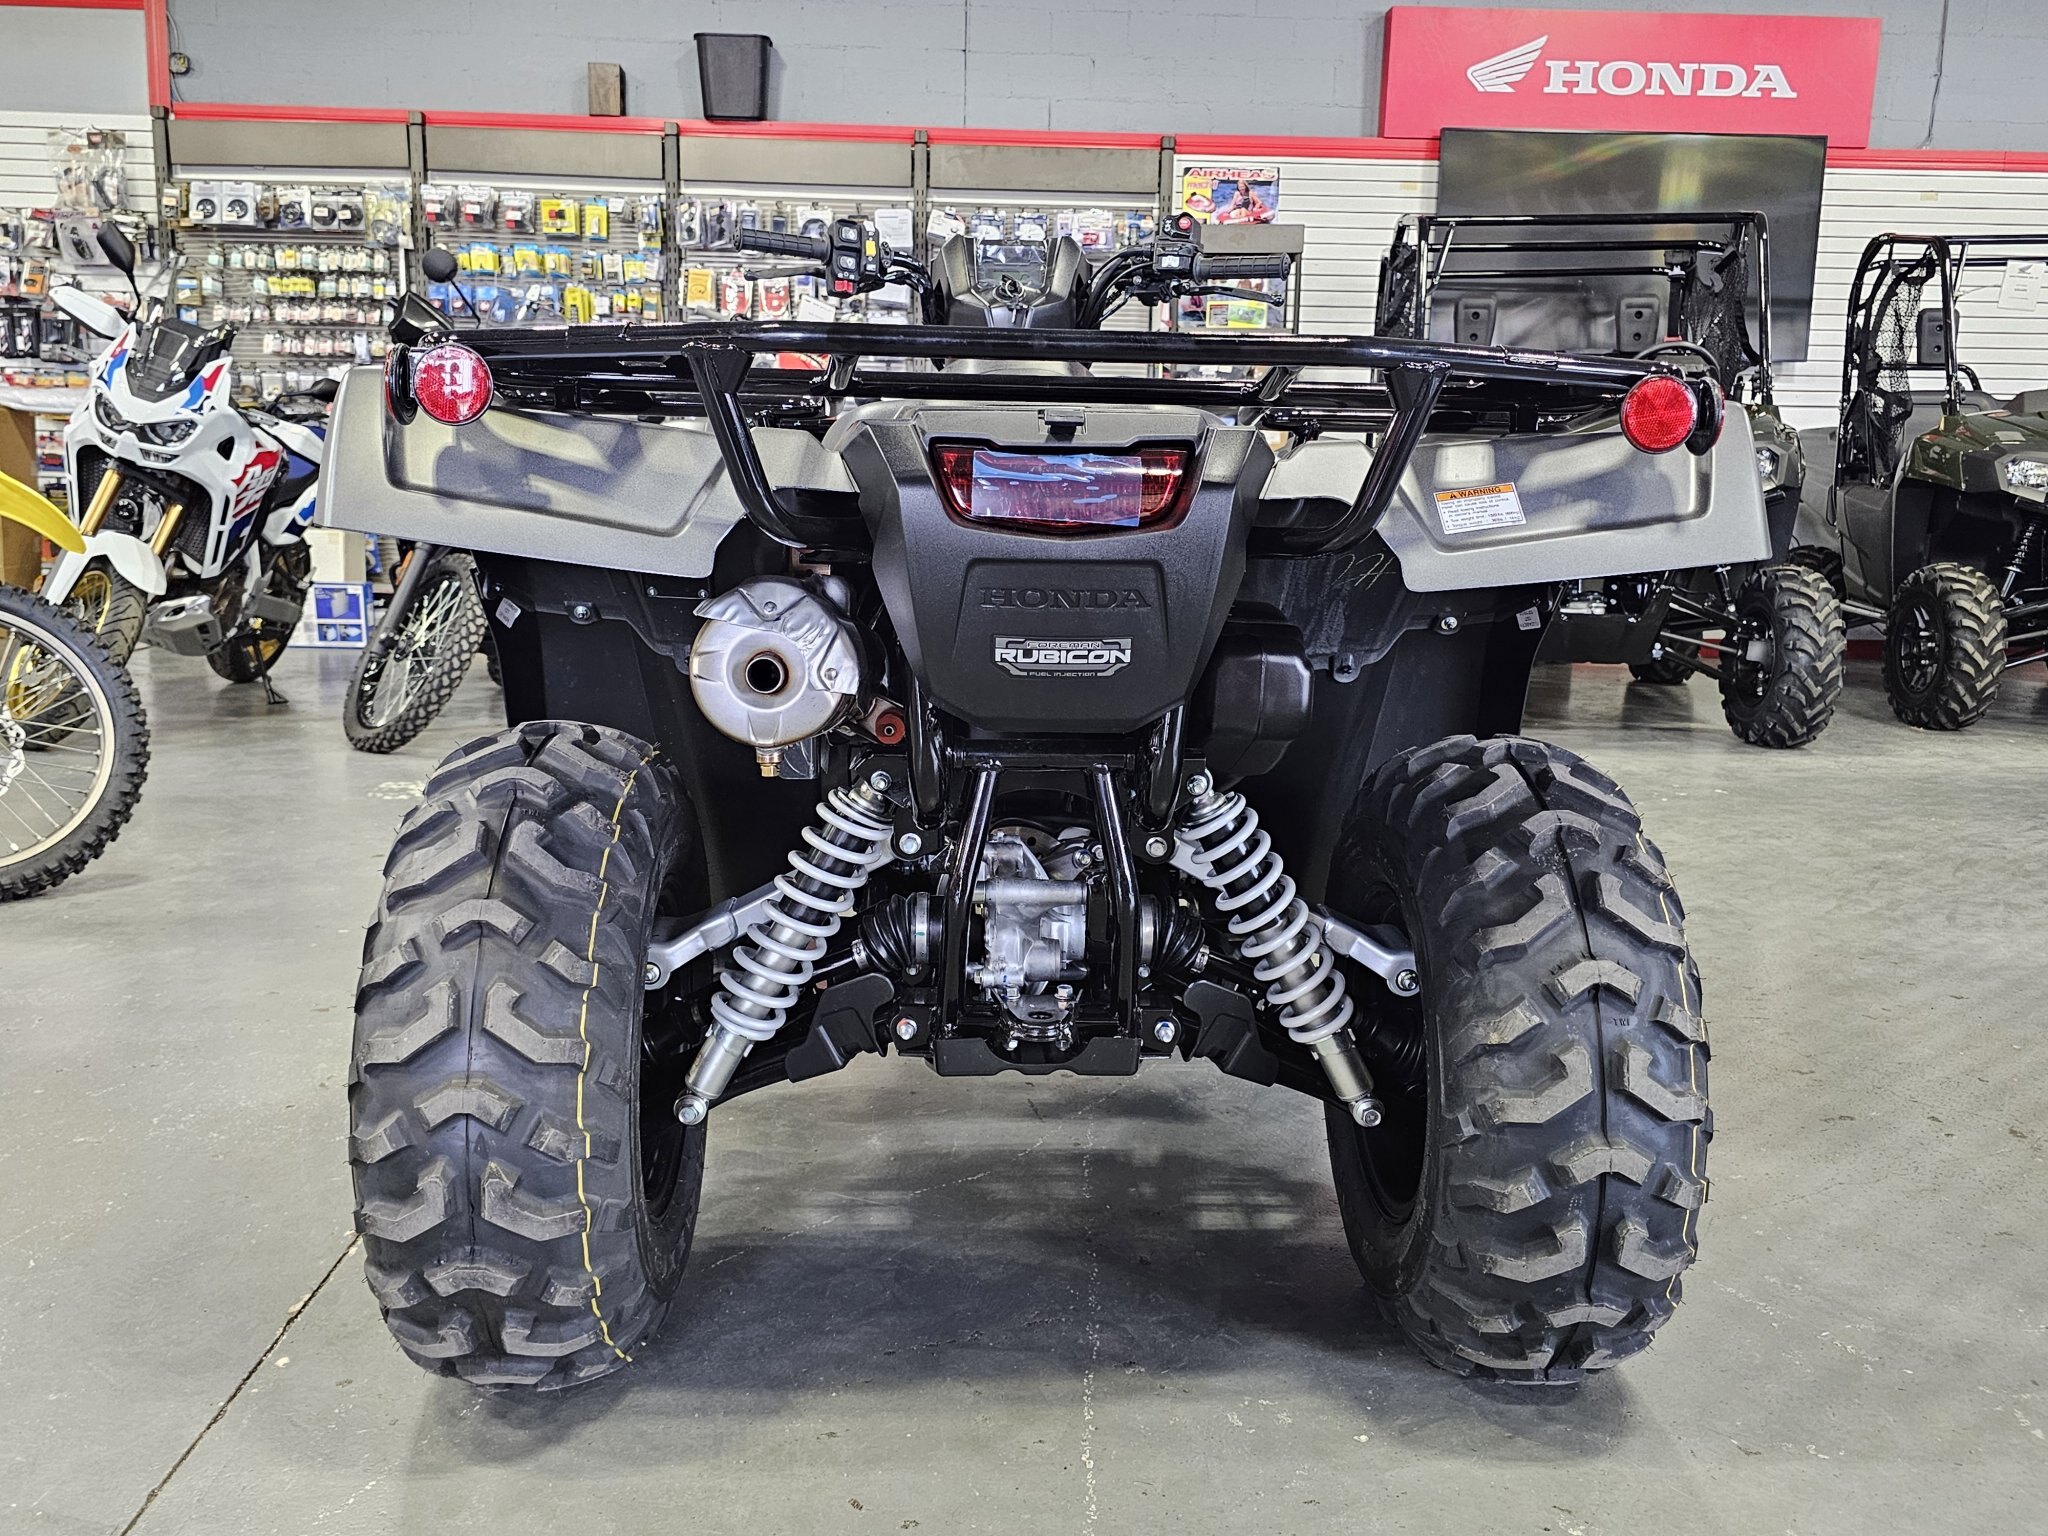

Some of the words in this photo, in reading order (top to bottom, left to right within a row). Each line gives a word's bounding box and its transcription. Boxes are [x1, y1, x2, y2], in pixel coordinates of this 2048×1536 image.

[1543, 60, 1797, 98] HONDA
[1458, 486, 1501, 497] WARNING
[980, 588, 1151, 609] HONDA
[1026, 641, 1101, 649] FOREMAN
[995, 648, 1131, 664] RUBICON
